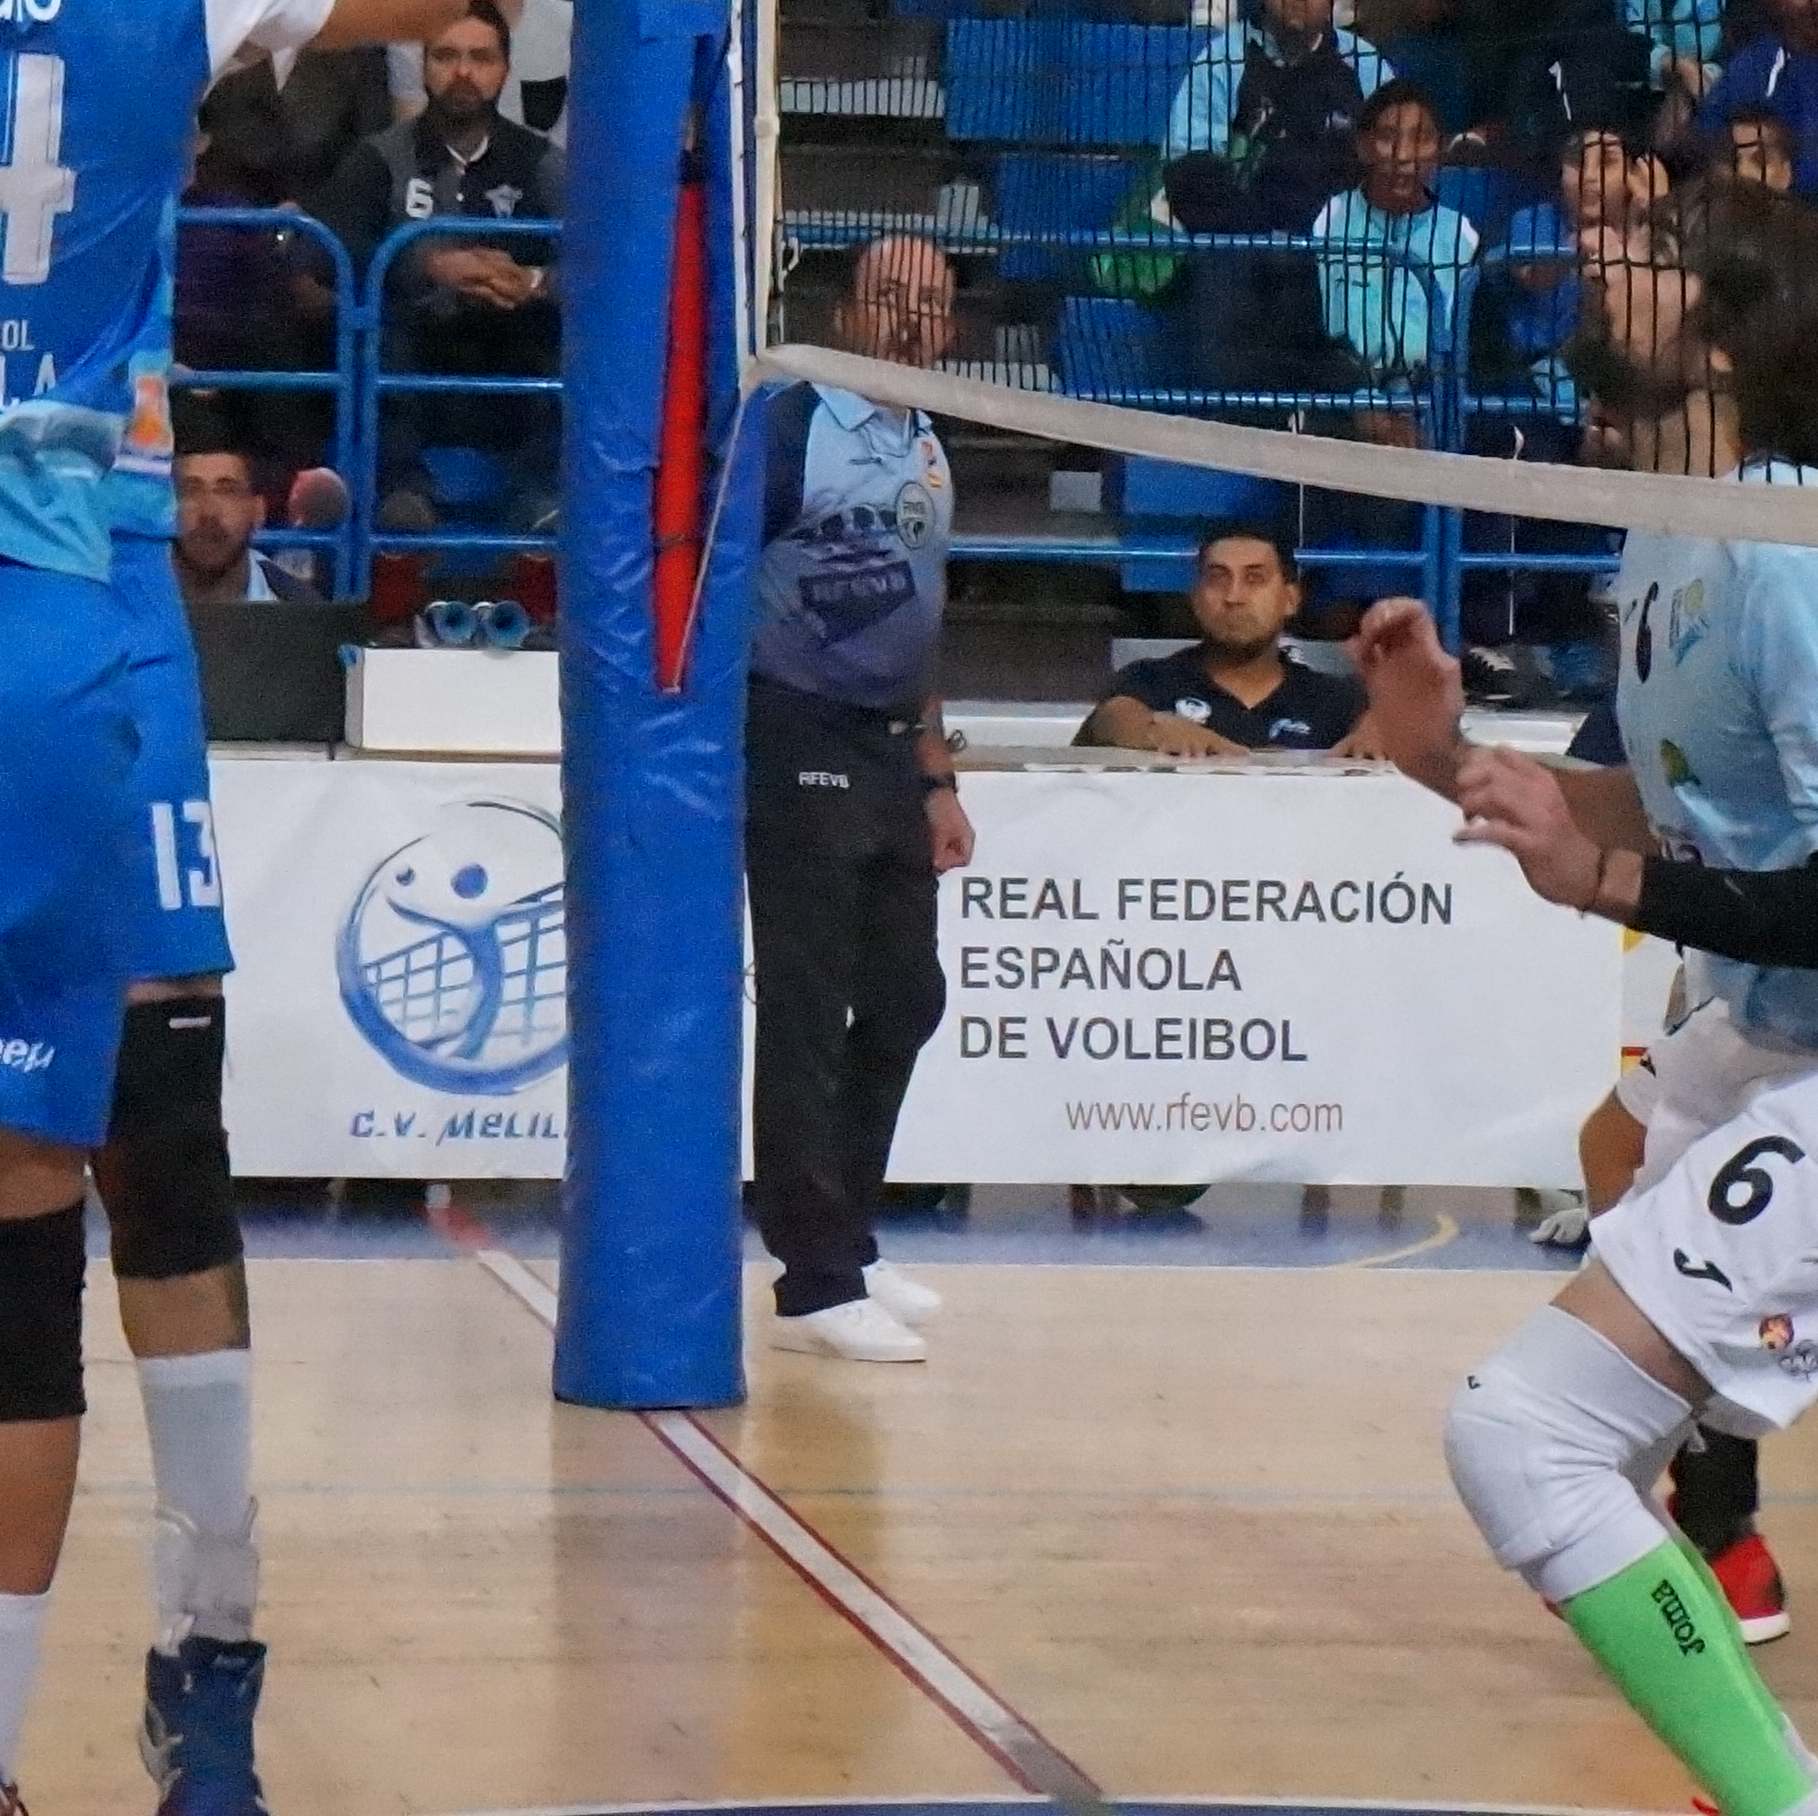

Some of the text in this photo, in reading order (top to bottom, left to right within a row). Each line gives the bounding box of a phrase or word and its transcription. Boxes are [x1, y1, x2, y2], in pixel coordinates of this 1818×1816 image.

[406, 178, 434, 220] 6
[152, 801, 222, 911] 13
[960, 871, 1454, 926] REAL FEDERACIÓN
[959, 939, 1243, 992] ESPAÑOLA
[959, 1016, 1308, 1062] DE VOLEIBOL
[1065, 1093, 1344, 1133] www.rfevb.com
[1706, 1134, 1808, 1226] 6
[1650, 1578, 1706, 1656] Joma
